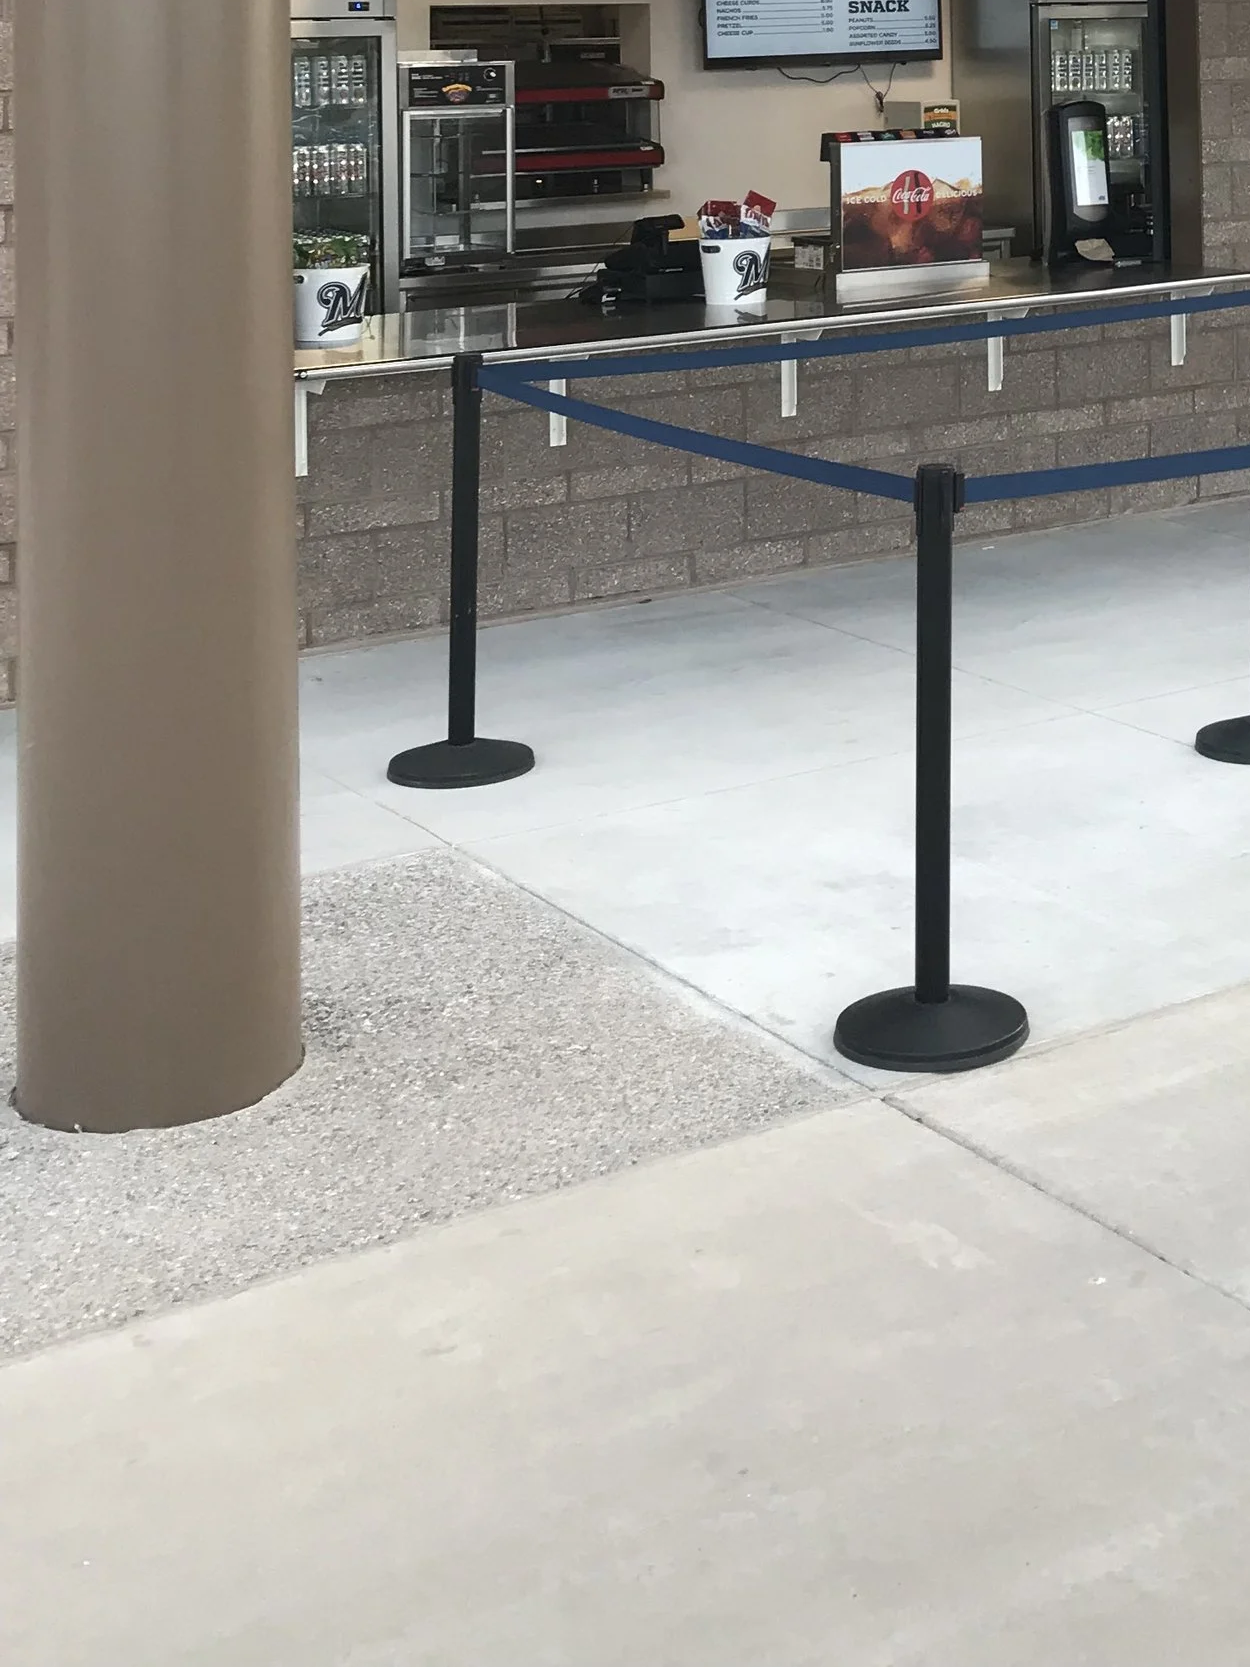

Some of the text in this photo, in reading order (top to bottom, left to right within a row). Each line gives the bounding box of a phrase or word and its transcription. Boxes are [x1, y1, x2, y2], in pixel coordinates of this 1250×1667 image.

[848, 0, 910, 14] SNACK
[846, 195, 887, 204] ICE COLD
